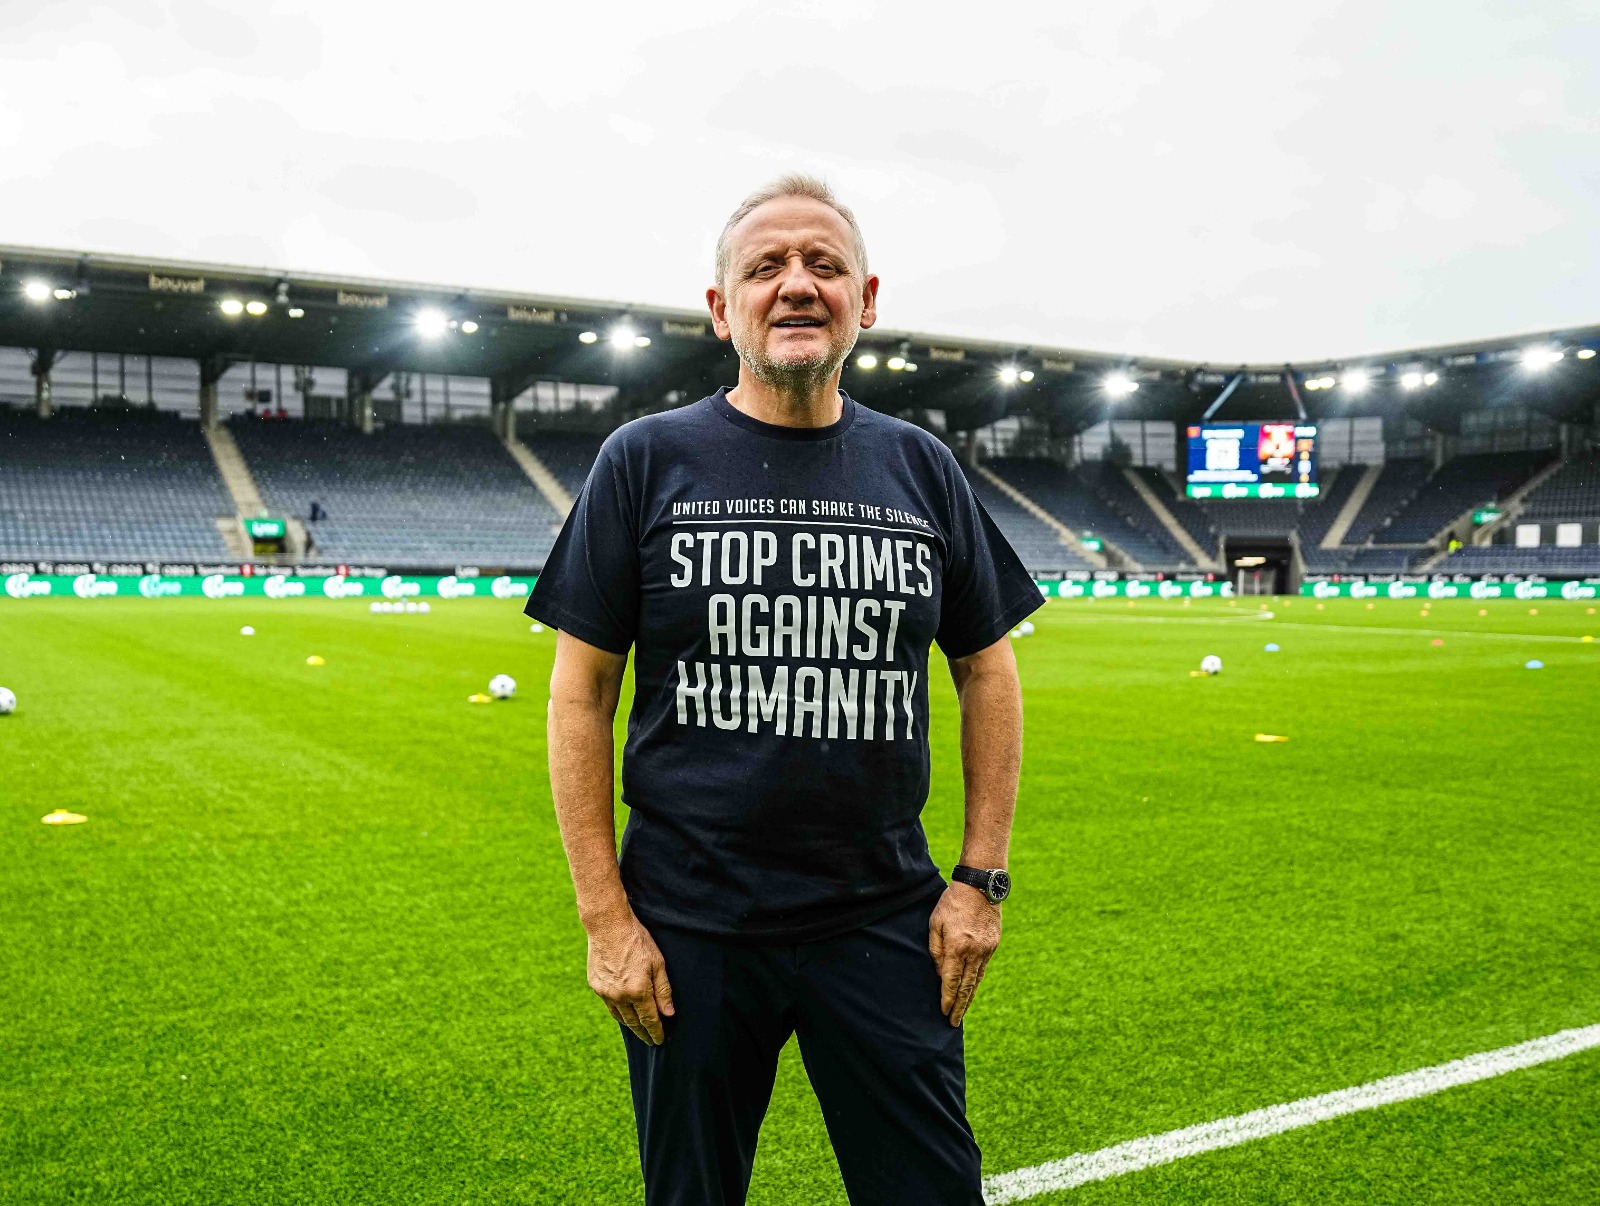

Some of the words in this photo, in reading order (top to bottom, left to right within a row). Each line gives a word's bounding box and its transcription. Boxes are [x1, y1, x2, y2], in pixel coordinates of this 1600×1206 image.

[672, 501, 720, 516] UNITED
[726, 499, 774, 514] VOICES
[780, 499, 806, 514] CAN
[812, 500, 854, 517] SHAKE
[859, 504, 882, 521] THE
[886, 508, 931, 529] SILENCE
[670, 530, 778, 588] STOP
[792, 532, 934, 598] CRIMES
[708, 593, 906, 662] AGAINST
[676, 660, 918, 741] HUMANITY
